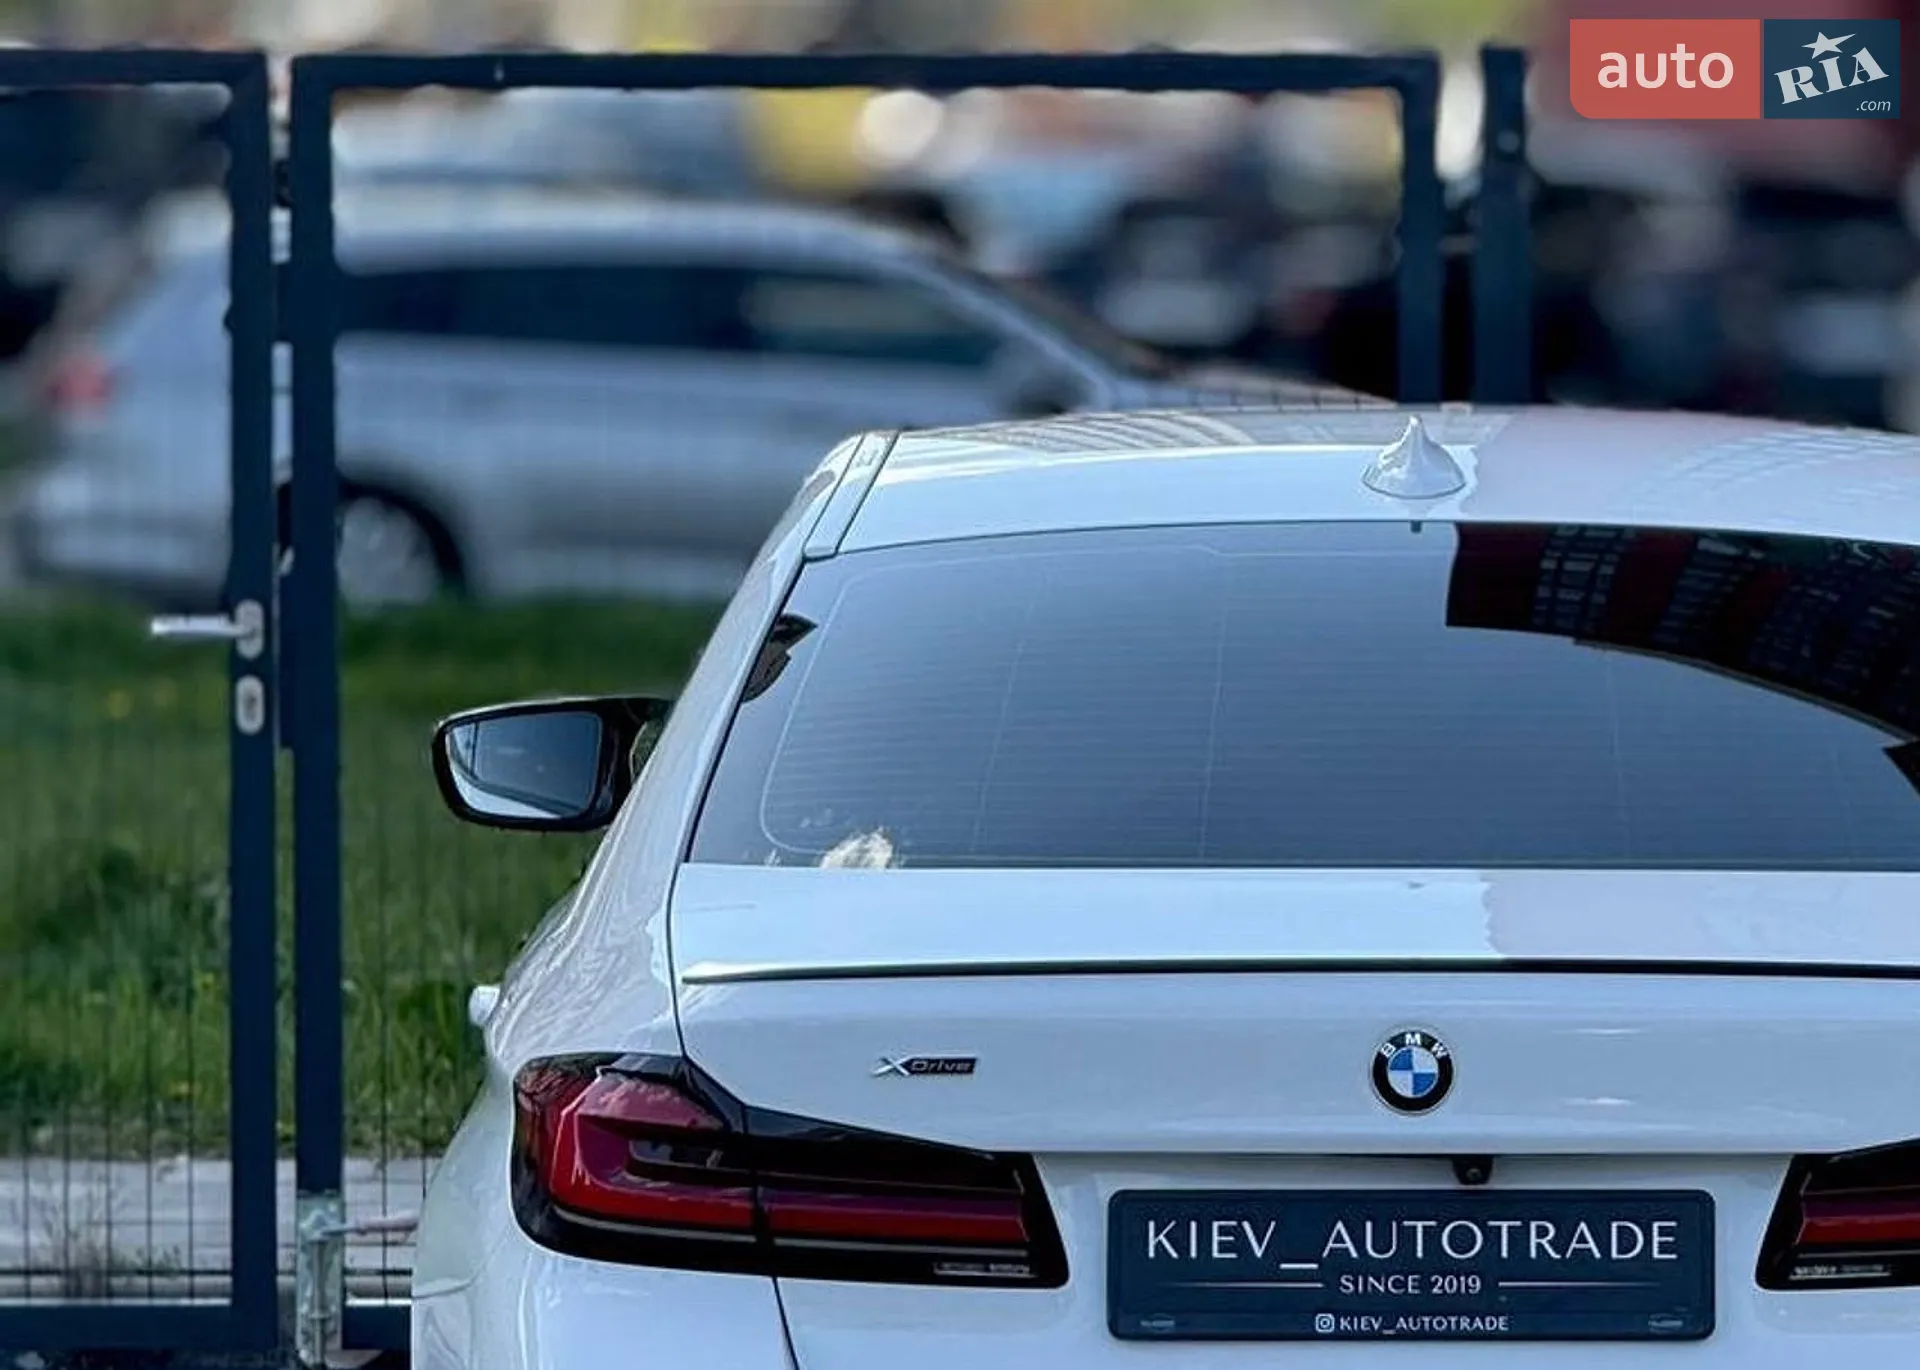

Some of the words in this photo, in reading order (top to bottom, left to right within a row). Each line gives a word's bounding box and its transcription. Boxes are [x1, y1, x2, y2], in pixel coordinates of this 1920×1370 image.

[1381, 1033, 1448, 1059] BMW
[1147, 1219, 1679, 1269] KIEV_AUTOTRADE
[1339, 1274, 1421, 1295] SINCE
[1430, 1274, 1483, 1295] 2019
[1339, 1315, 1510, 1335] KIEV_AUTOTRADE
